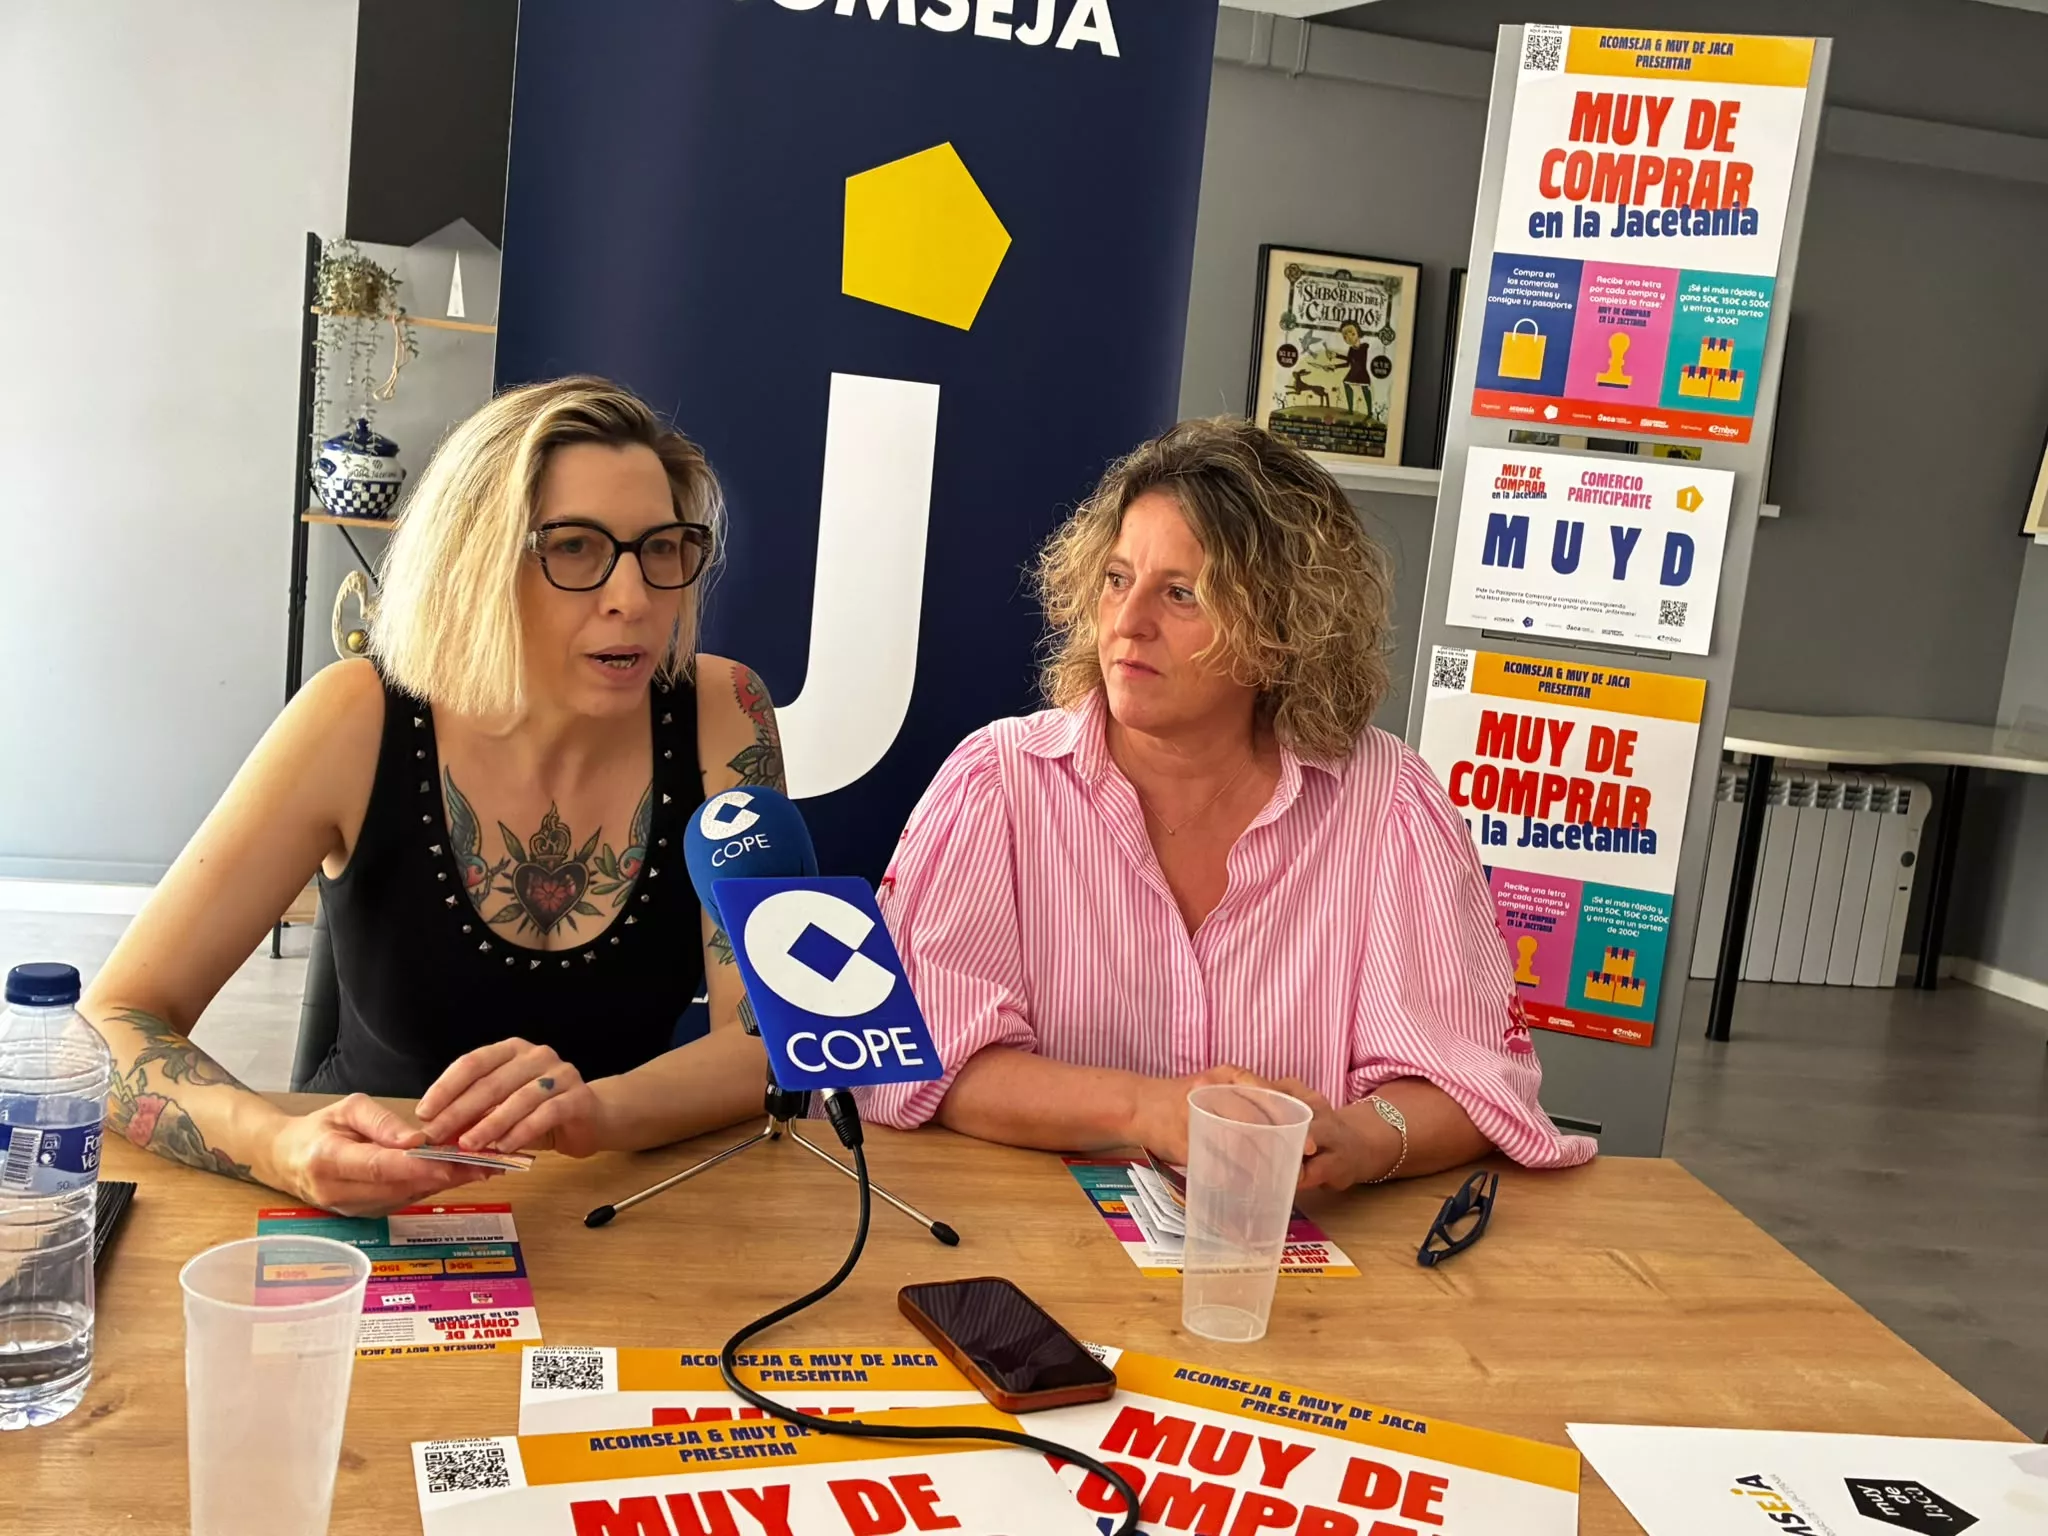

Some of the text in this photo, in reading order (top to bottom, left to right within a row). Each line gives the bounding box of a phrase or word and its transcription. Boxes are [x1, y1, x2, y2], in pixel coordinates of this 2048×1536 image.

[1599, 35, 1734, 56] ACOMSEJA & MUY DE JACA
[1635, 55, 1692, 71] PRESENTAN
[1568, 90, 1741, 153] MUY DE
[1539, 147, 1754, 212] COMPRAR
[1528, 201, 1759, 238] en la Jacetania
[1513, 268, 1544, 278] Compra
[1507, 277, 1559, 289] los comercios
[1596, 275, 1662, 289] Recibe una letra
[1303, 284, 1364, 304] SABORES
[1503, 287, 1560, 300] participantes y
[1589, 286, 1666, 300] por cada compra y
[1688, 283, 1764, 299] ¡Sé el más rápido y
[1488, 295, 1521, 305] consigue
[1532, 300, 1573, 310] pasaporte
[1589, 295, 1663, 309] completa la frase:
[1680, 294, 1701, 303] gana
[1721, 297, 1740, 306] 150€
[1748, 300, 1770, 308] 500€
[1306, 301, 1375, 326] CAMINO
[1689, 305, 1712, 313] entra
[1737, 309, 1764, 318] sorteo
[1703, 315, 1715, 323] de
[1501, 463, 1542, 480] MUY DE
[1494, 477, 1546, 493] COMPRAR
[1580, 471, 1643, 492] COMERCIO
[1492, 490, 1547, 500] en la Jacetania
[1567, 487, 1652, 510] PARTICIPANTE
[1504, 661, 1631, 688] ACOMSEJA & MUY DE JACA
[1538, 681, 1591, 699] PRESENTAN
[1475, 710, 1638, 778] MUY DE
[1448, 760, 1651, 831] COMPRAR
[1481, 814, 1507, 847] la
[1517, 816, 1657, 855] Jacetania
[711, 833, 771, 868] COPE
[1504, 882, 1529, 892] Recibe
[1548, 889, 1566, 898] letra
[1498, 900, 1534, 911] completa
[1545, 906, 1568, 916] frase:
[1513, 893, 1532, 902] cada
[1534, 897, 1563, 907] compra
[1605, 898, 1612, 906] el
[1613, 900, 1630, 908] más
[1631, 902, 1656, 912] rápido
[1657, 907, 1663, 915] y
[1583, 905, 1603, 913] gana
[1623, 910, 1641, 919] 150€
[1649, 914, 1669, 924] 500€
[1586, 914, 1592, 922] y
[1593, 915, 1614, 924] entra
[1638, 922, 1663, 932] sorteo
[1607, 926, 1617, 934] de
[786, 1026, 924, 1073] COPE
[428, 1313, 487, 1324] Jacetania
[434, 1318, 520, 1331] COMPRAR
[445, 1328, 512, 1340] MUY DE
[361, 1343, 496, 1356] ACOMSEJA MUY DE JACA
[790, 1354, 803, 1366] &
[810, 1354, 853, 1366] MUY
[862, 1354, 885, 1366] DE
[891, 1354, 938, 1366] JACA
[760, 1369, 868, 1382] PRESENTAN
[1174, 1367, 1428, 1434] ACOMSEJA & MUY DE JACA
[1241, 1397, 1347, 1430] PRESENTAN
[590, 1433, 700, 1452] ACOMSEJA
[709, 1429, 723, 1443] &
[731, 1426, 777, 1442] MUY
[681, 1442, 797, 1462] PRESENTAN
[1099, 1405, 1449, 1525] MUY DE
[1857, 1484, 1901, 1517] muy
[1885, 1486, 1911, 1504] de
[570, 1473, 961, 1536] MUY DE
